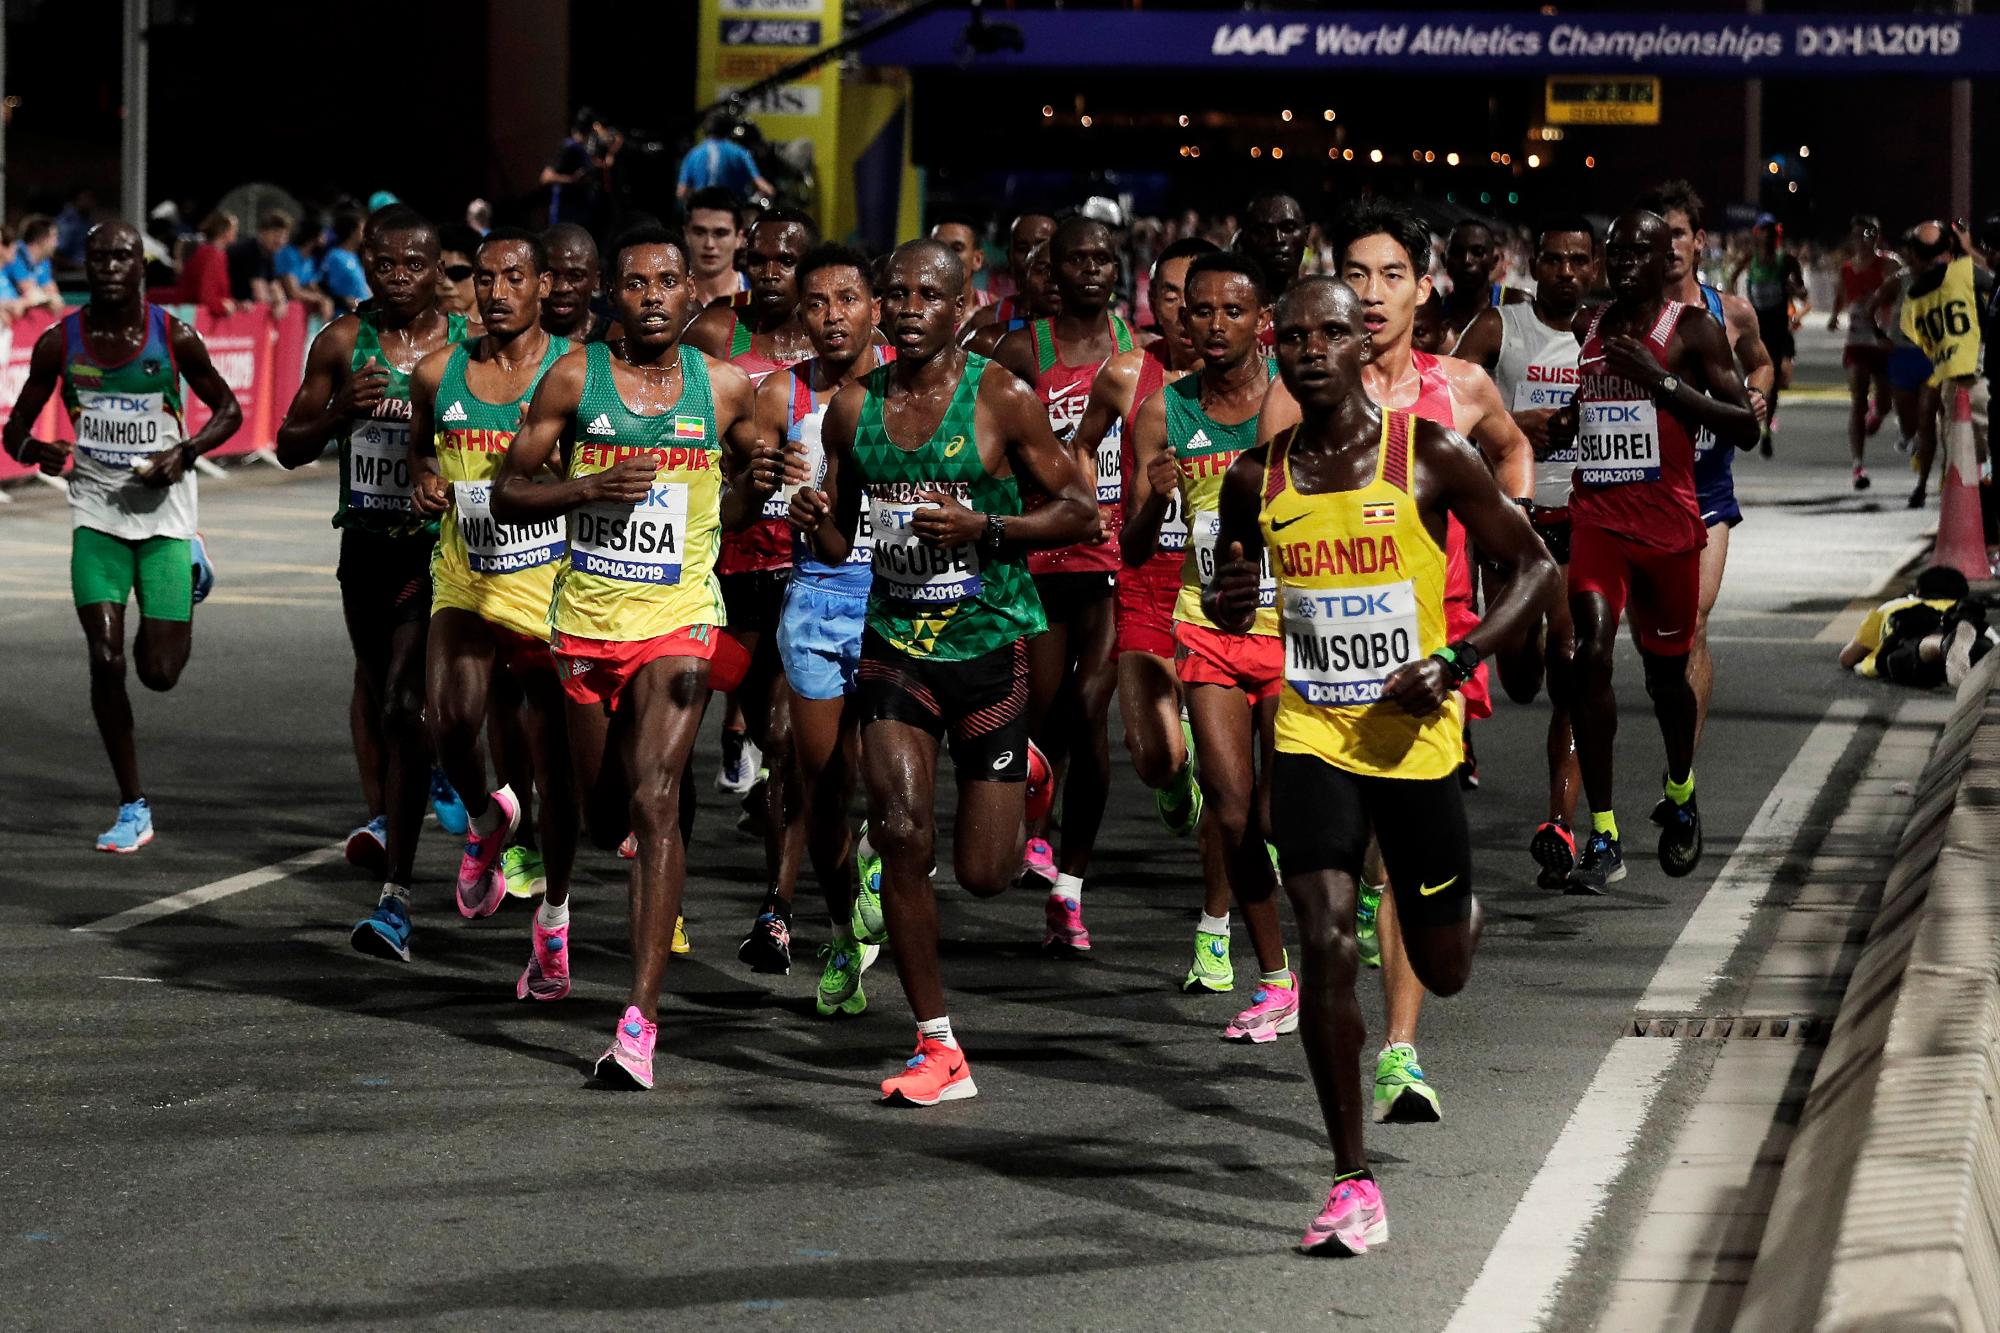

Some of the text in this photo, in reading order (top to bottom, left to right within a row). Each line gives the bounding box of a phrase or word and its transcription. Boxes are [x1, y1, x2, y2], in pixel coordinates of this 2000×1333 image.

[1211, 23, 1961, 62] IAAF World Athletics Championships DOHA2019
[1527, 365, 1580, 384] SUIS
[110, 397, 149, 411] TDK
[371, 398, 413, 420] MBA
[1545, 389, 1575, 405] TD
[1595, 406, 1641, 422] TDK
[83, 416, 156, 444] RAINHOLD
[444, 429, 514, 454] ETHIO
[586, 426, 616, 437] adidas
[1581, 433, 1651, 461] SEUREI
[355, 454, 410, 488] MPO
[1097, 450, 1121, 477] NGA
[1181, 450, 1240, 479] ETH
[1582, 469, 1644, 483] DOHA2019
[363, 494, 411, 511] DOHA2
[578, 511, 676, 555] DESISA
[480, 547, 551, 571] DOHA2019
[586, 556, 664, 581] DOHA2019
[875, 539, 970, 576] NCUBE
[1277, 535, 1399, 578] UGANDA
[888, 584, 965, 601] DOHA2019
[1316, 592, 1393, 618] TDK
[1292, 627, 1410, 672] MUSOBO
[1308, 683, 1384, 703] DOHA20
